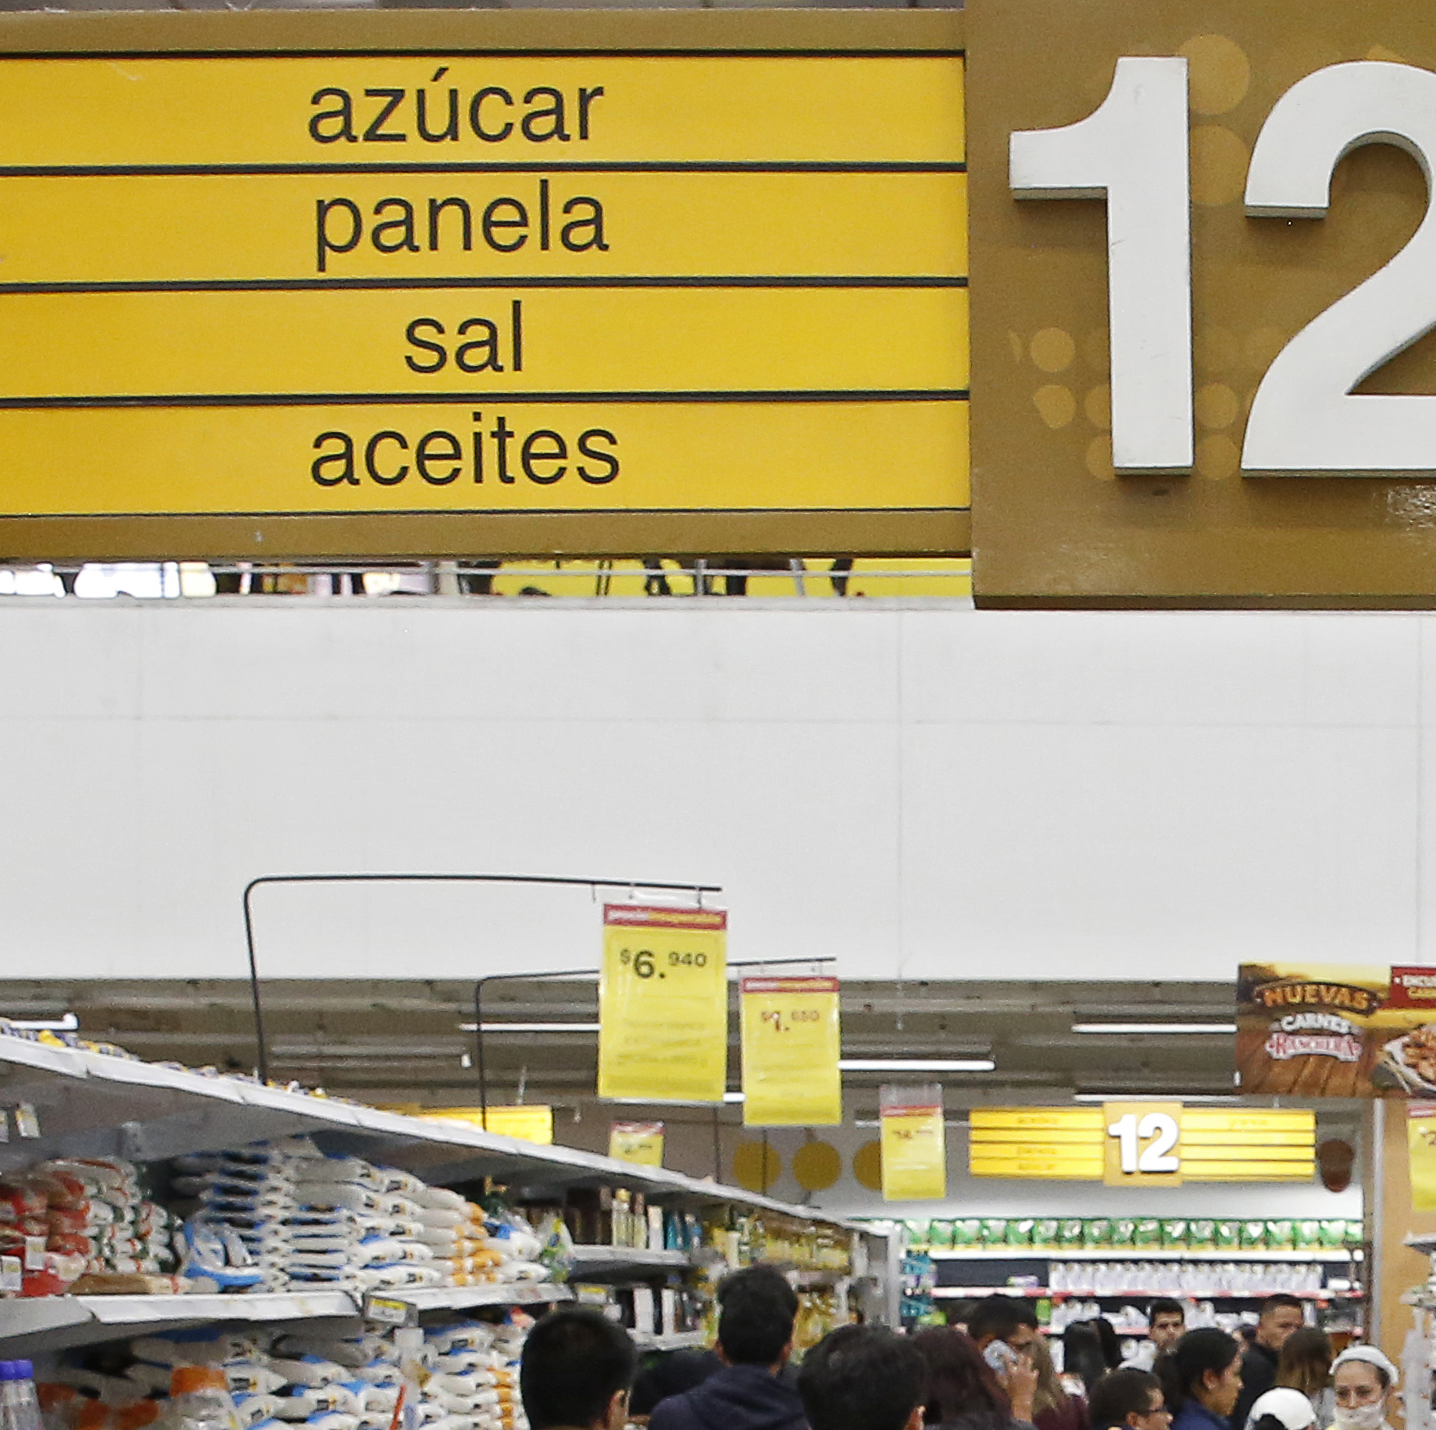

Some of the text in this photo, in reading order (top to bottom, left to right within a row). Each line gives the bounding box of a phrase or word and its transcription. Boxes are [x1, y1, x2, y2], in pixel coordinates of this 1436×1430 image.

[307, 68, 606, 145] azúcar
[315, 180, 610, 272] panela
[403, 300, 526, 375] sal
[309, 411, 621, 489] aceites
[619, 948, 707, 979] $6.940
[1108, 1112, 1179, 1174] 12
